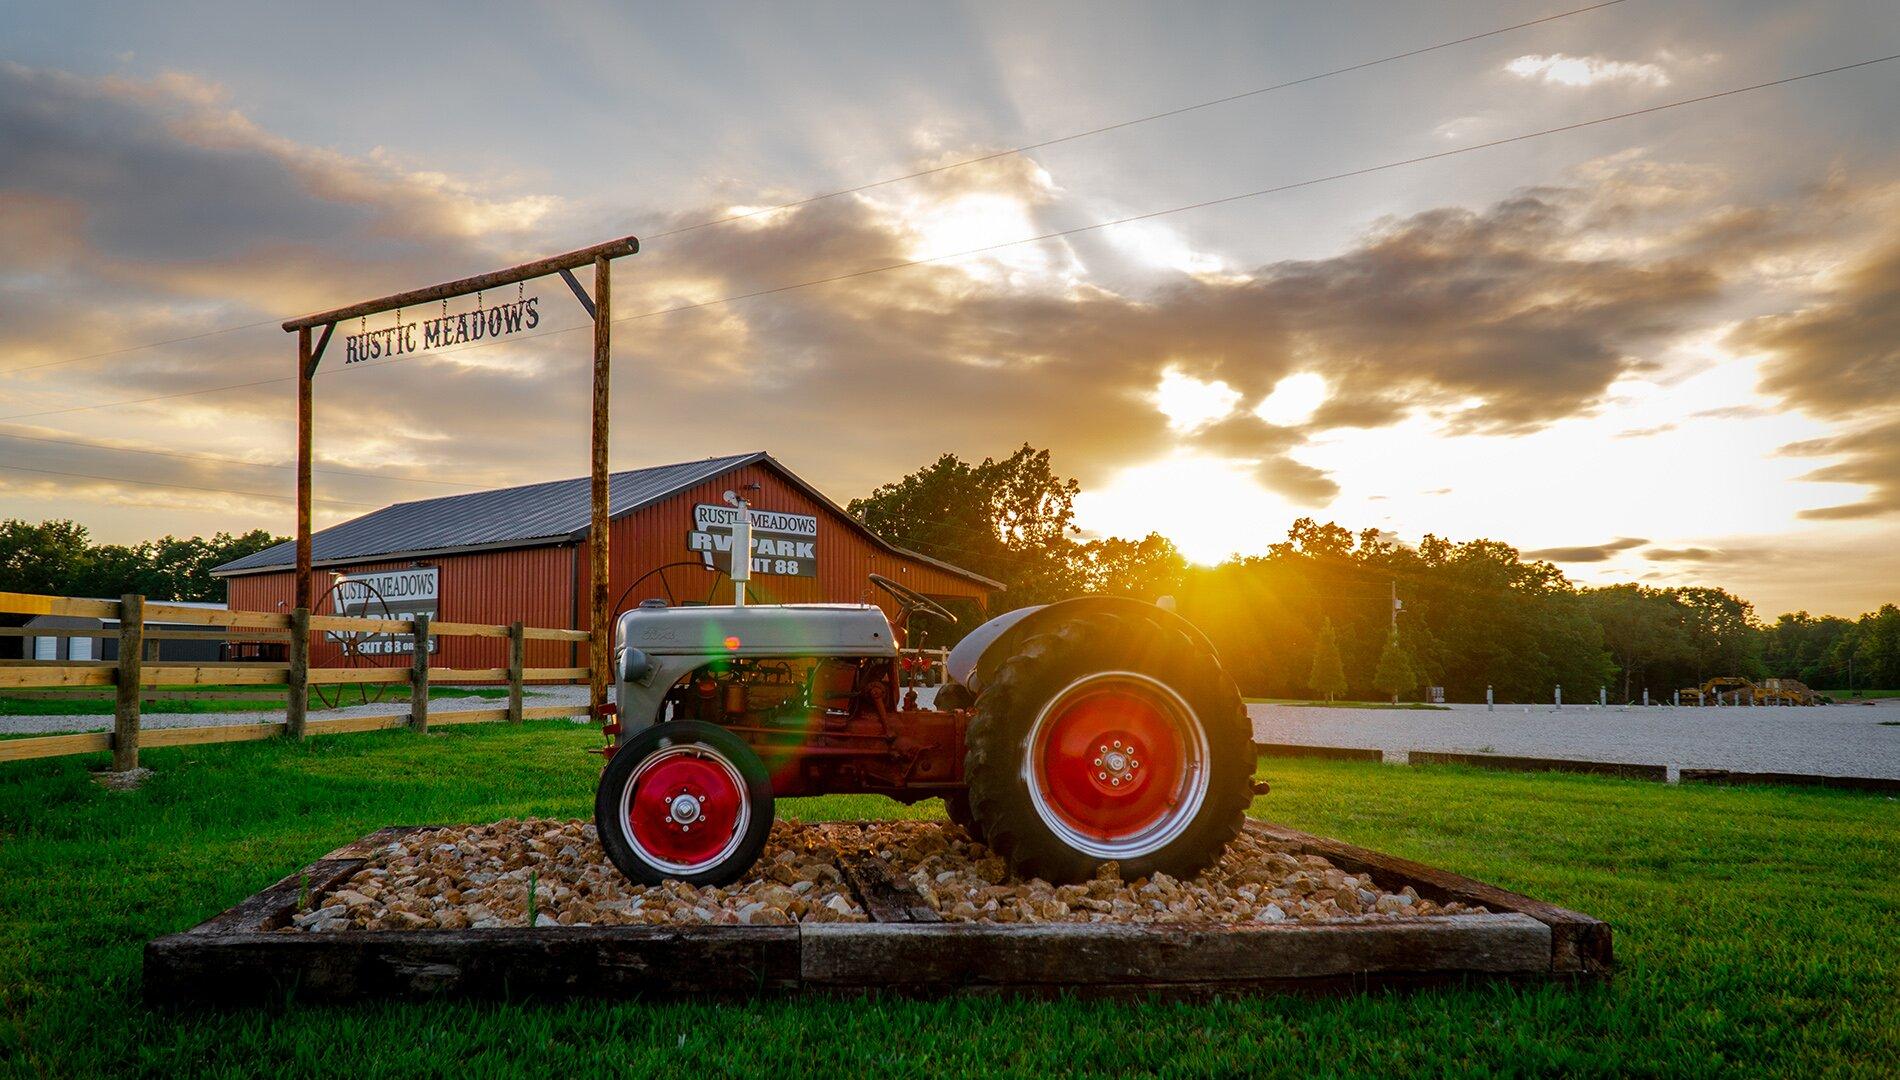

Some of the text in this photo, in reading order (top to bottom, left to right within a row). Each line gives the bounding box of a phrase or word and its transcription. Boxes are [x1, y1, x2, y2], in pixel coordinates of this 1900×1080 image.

[345, 297, 539, 364] RUSTIC MEADOWS
[698, 507, 816, 533] RUSTI MEADOWS
[692, 532, 732, 551] RV
[775, 559, 799, 575] 88
[377, 573, 434, 597] MEADOWS
[358, 641, 382, 654] EXIT
